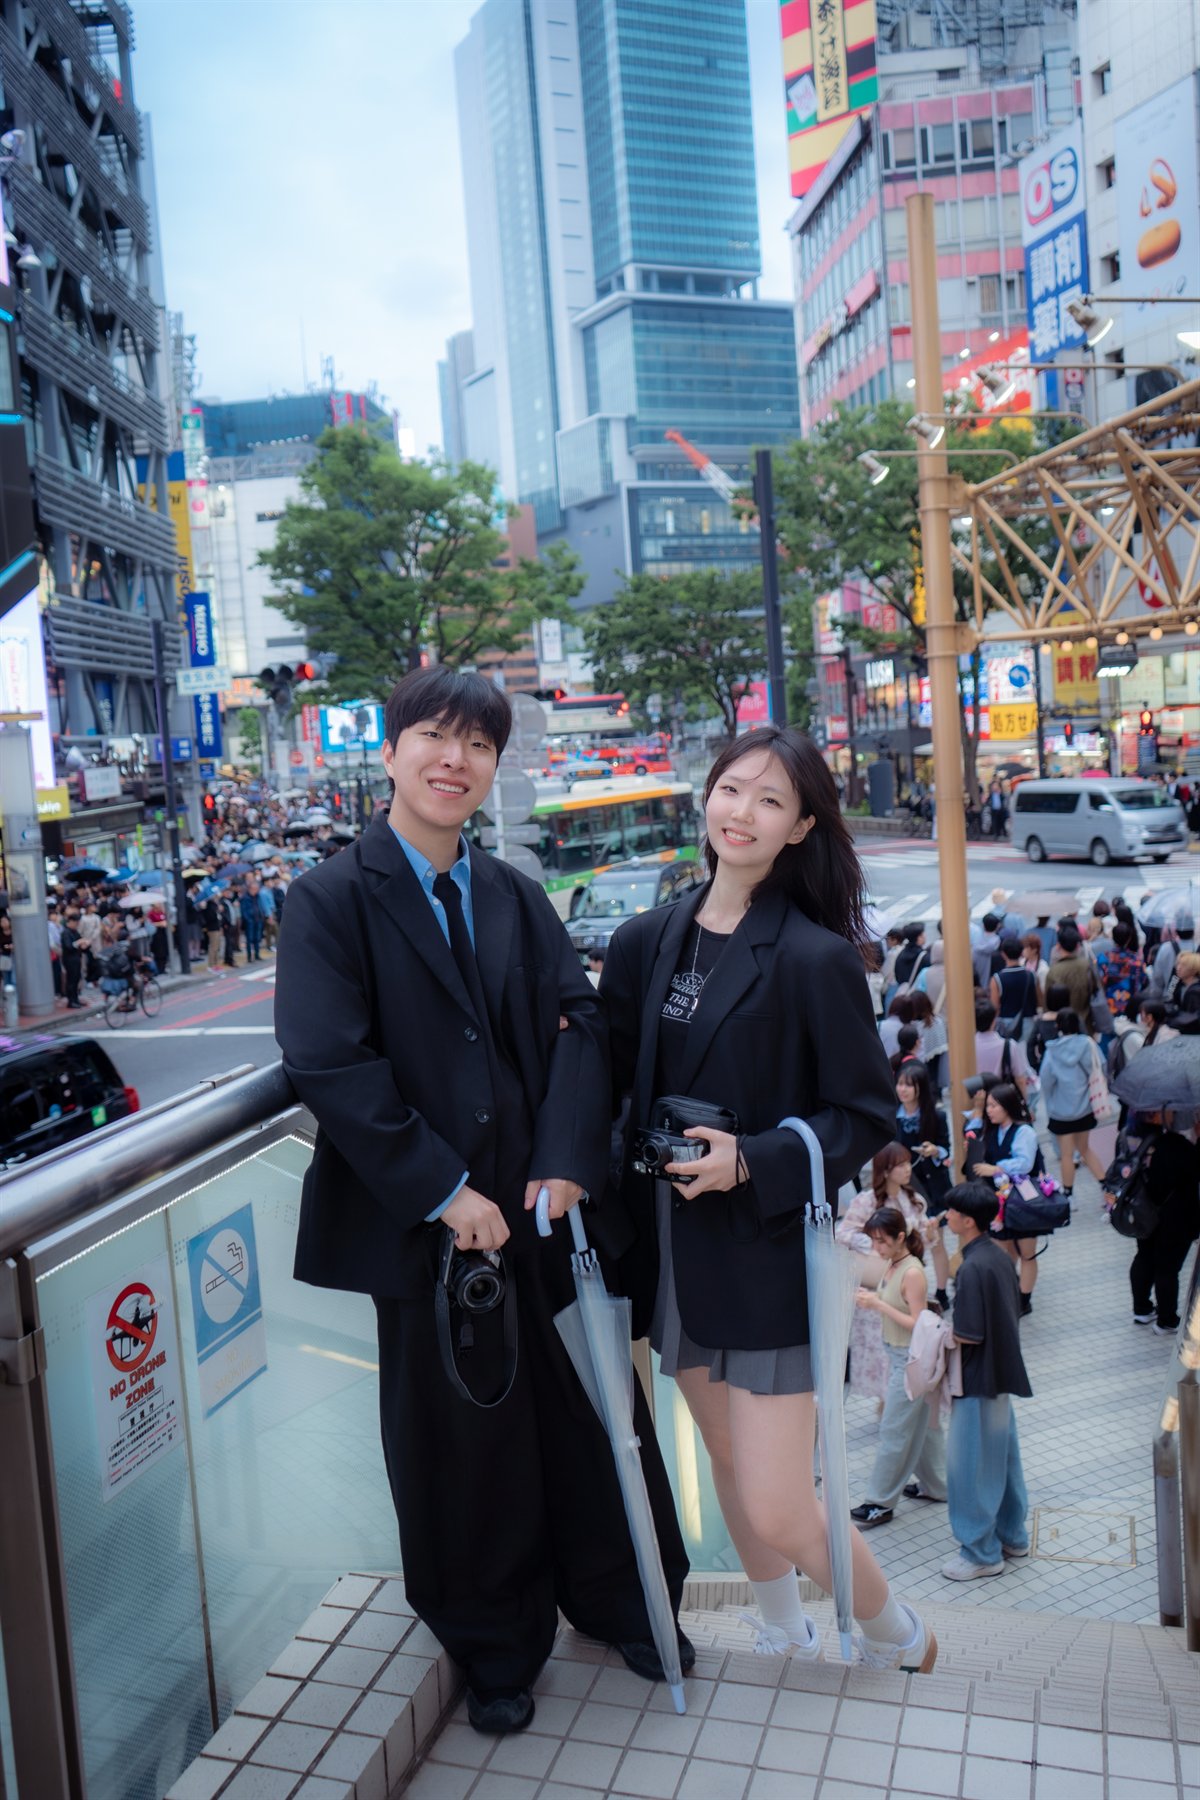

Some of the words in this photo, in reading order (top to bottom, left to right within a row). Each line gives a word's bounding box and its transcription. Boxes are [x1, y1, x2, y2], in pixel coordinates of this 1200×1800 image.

[1027, 149, 1077, 218] OS
[1030, 222, 1082, 302] 調剤
[194, 604, 209, 656] MIZUHO
[866, 659, 894, 688] LUSH
[661, 1003, 683, 1017] IND
[668, 991, 690, 1007] THE
[109, 1379, 126, 1400] NO
[129, 1350, 167, 1387] DRONE
[125, 1377, 155, 1409] ZONE
